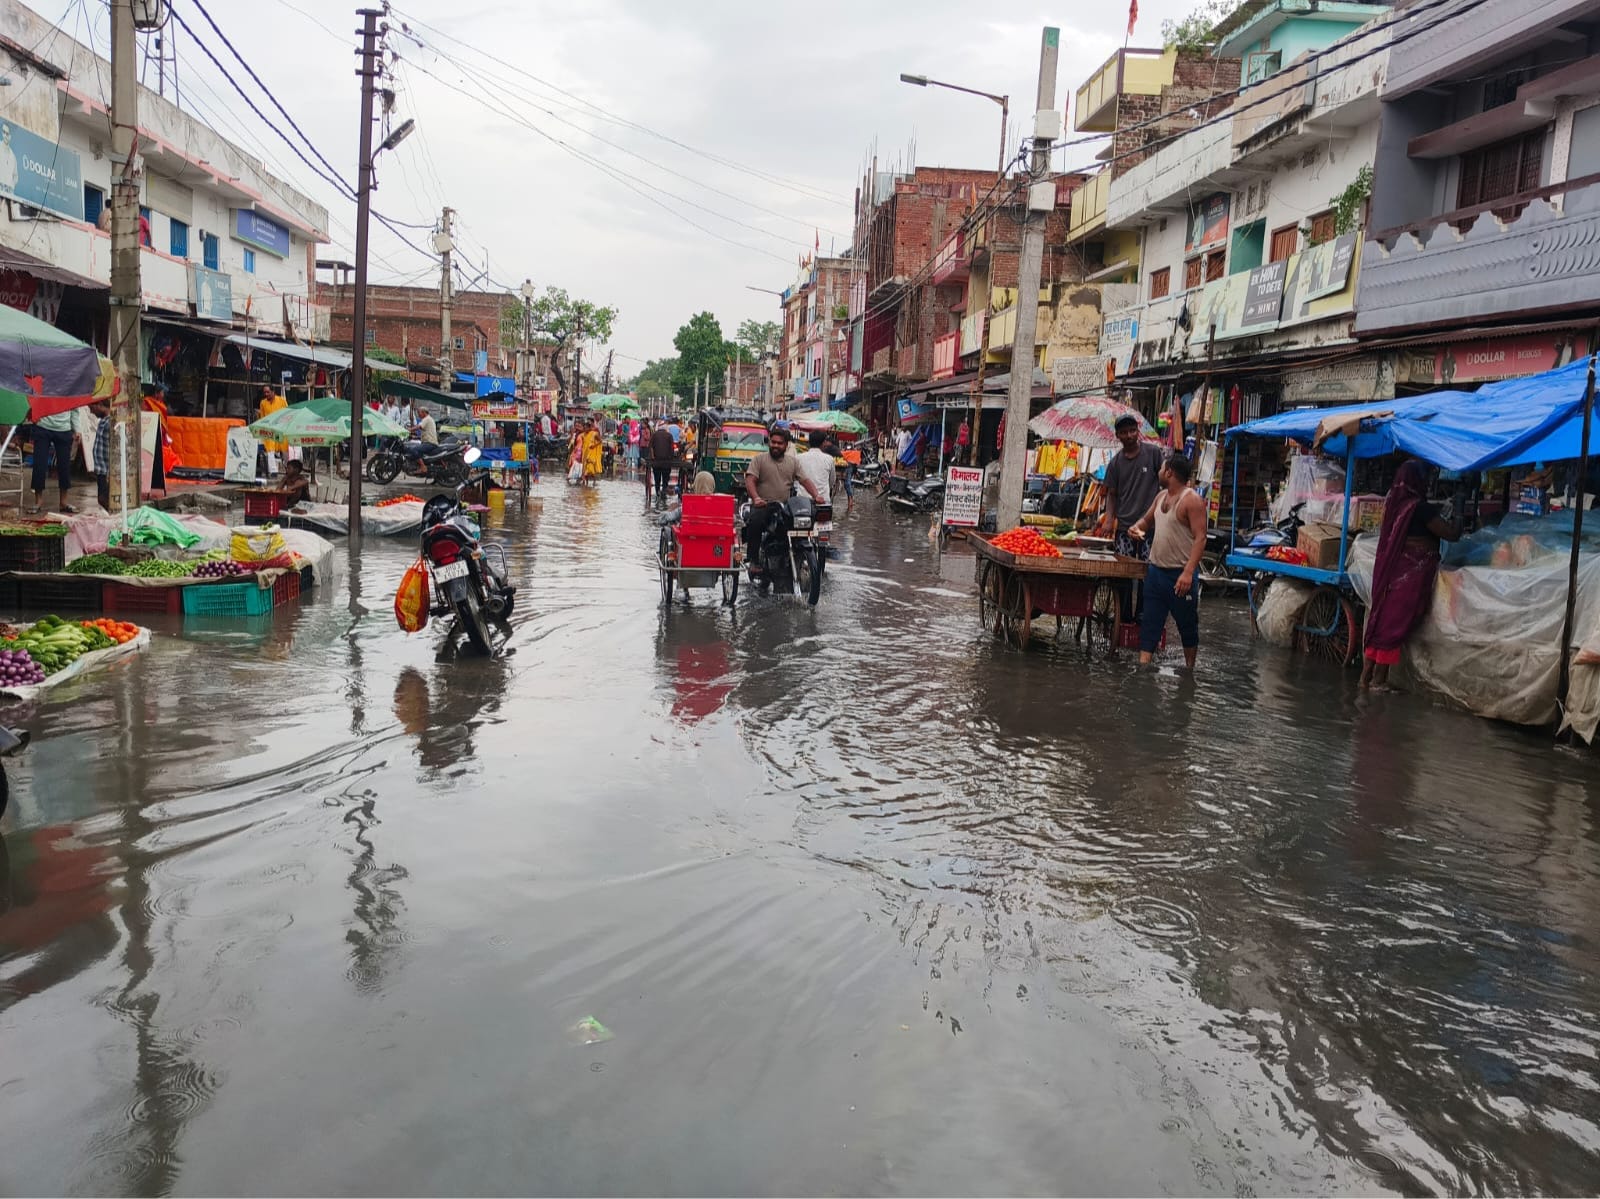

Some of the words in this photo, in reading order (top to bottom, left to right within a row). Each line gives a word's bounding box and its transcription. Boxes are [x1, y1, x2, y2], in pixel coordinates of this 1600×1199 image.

[29, 159, 57, 181] DOLLAR
[1259, 263, 1281, 283] HINT
[1256, 284, 1266, 297] TO
[1257, 301, 1277, 315] HINT
[1474, 350, 1505, 365] DOLLAR
[951, 468, 981, 482] हिमालय
